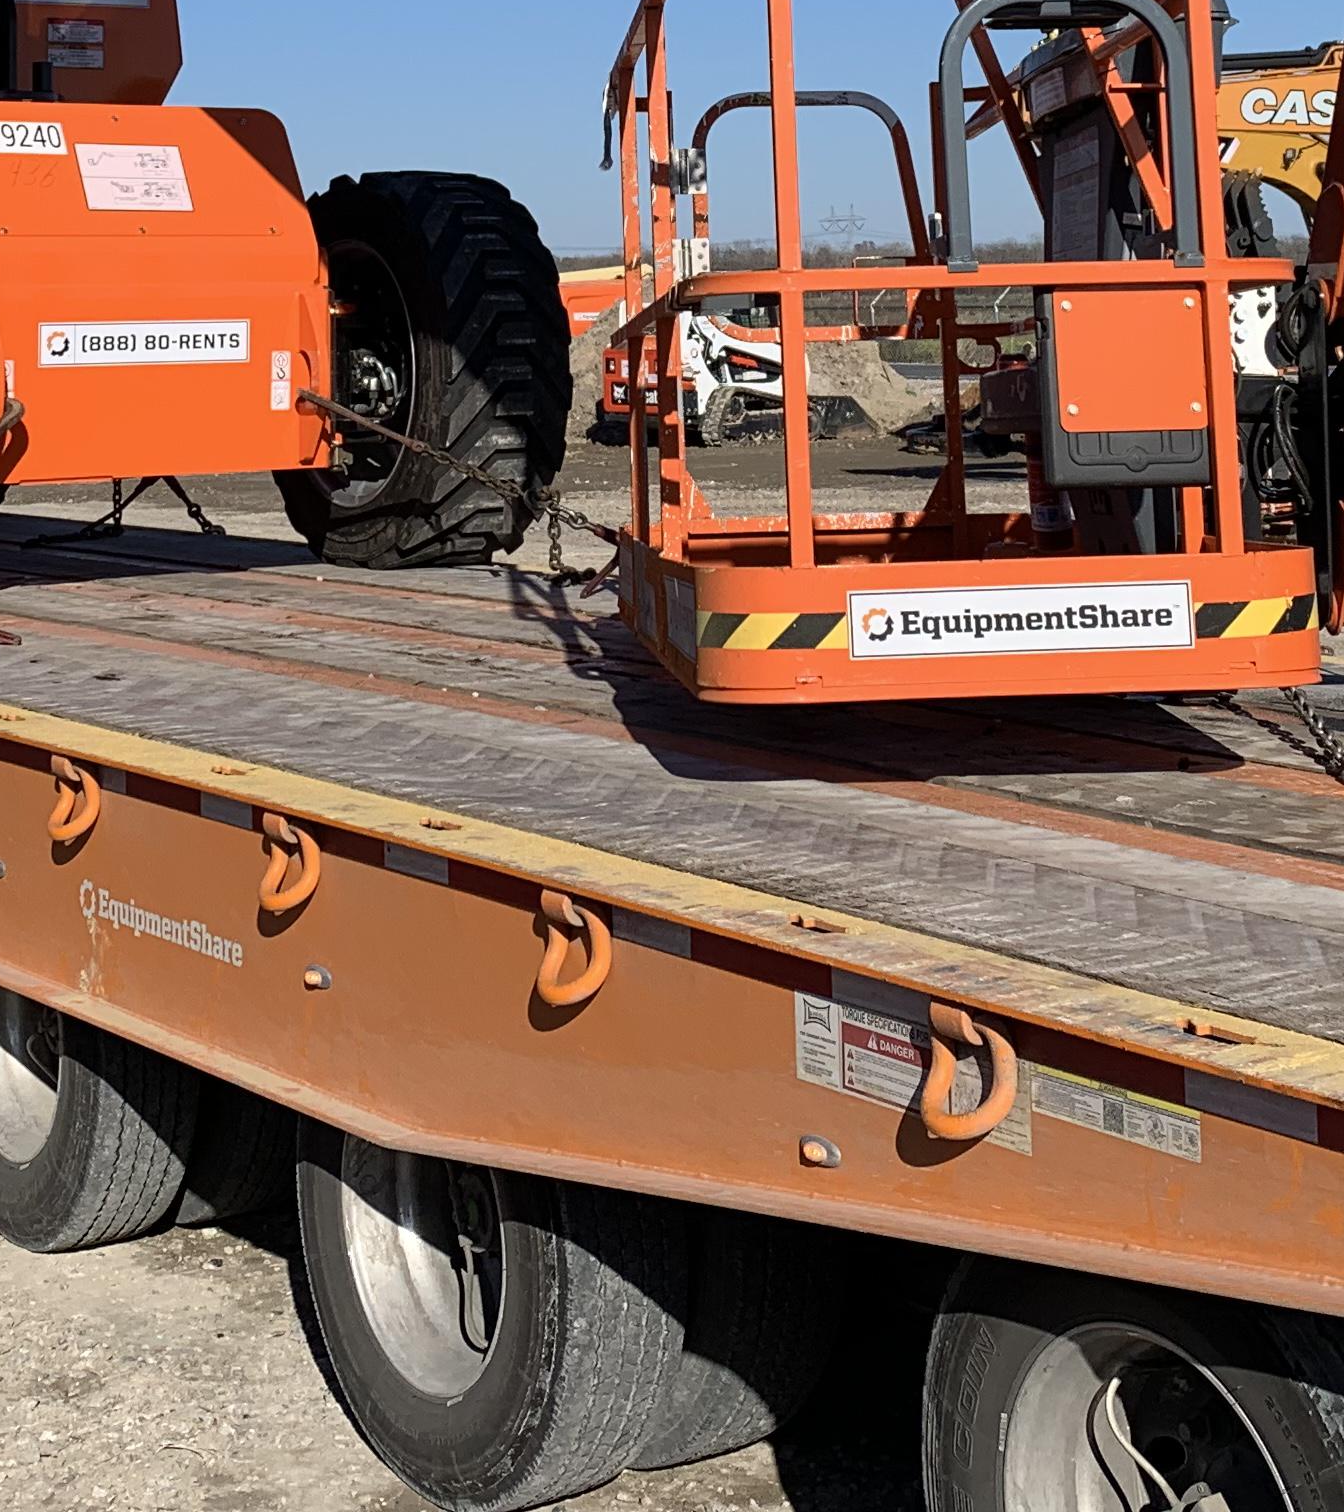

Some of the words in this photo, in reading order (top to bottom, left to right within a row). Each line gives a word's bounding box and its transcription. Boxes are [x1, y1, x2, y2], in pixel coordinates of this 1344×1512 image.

[1239, 87, 1337, 126] CAS
[82, 334, 136, 353] (888)
[145, 333, 241, 351] 80-RENTS
[901, 603, 1174, 640] EquipmentShare
[98, 887, 244, 968] EquipmentShare
[879, 1039, 915, 1061] DANGER
